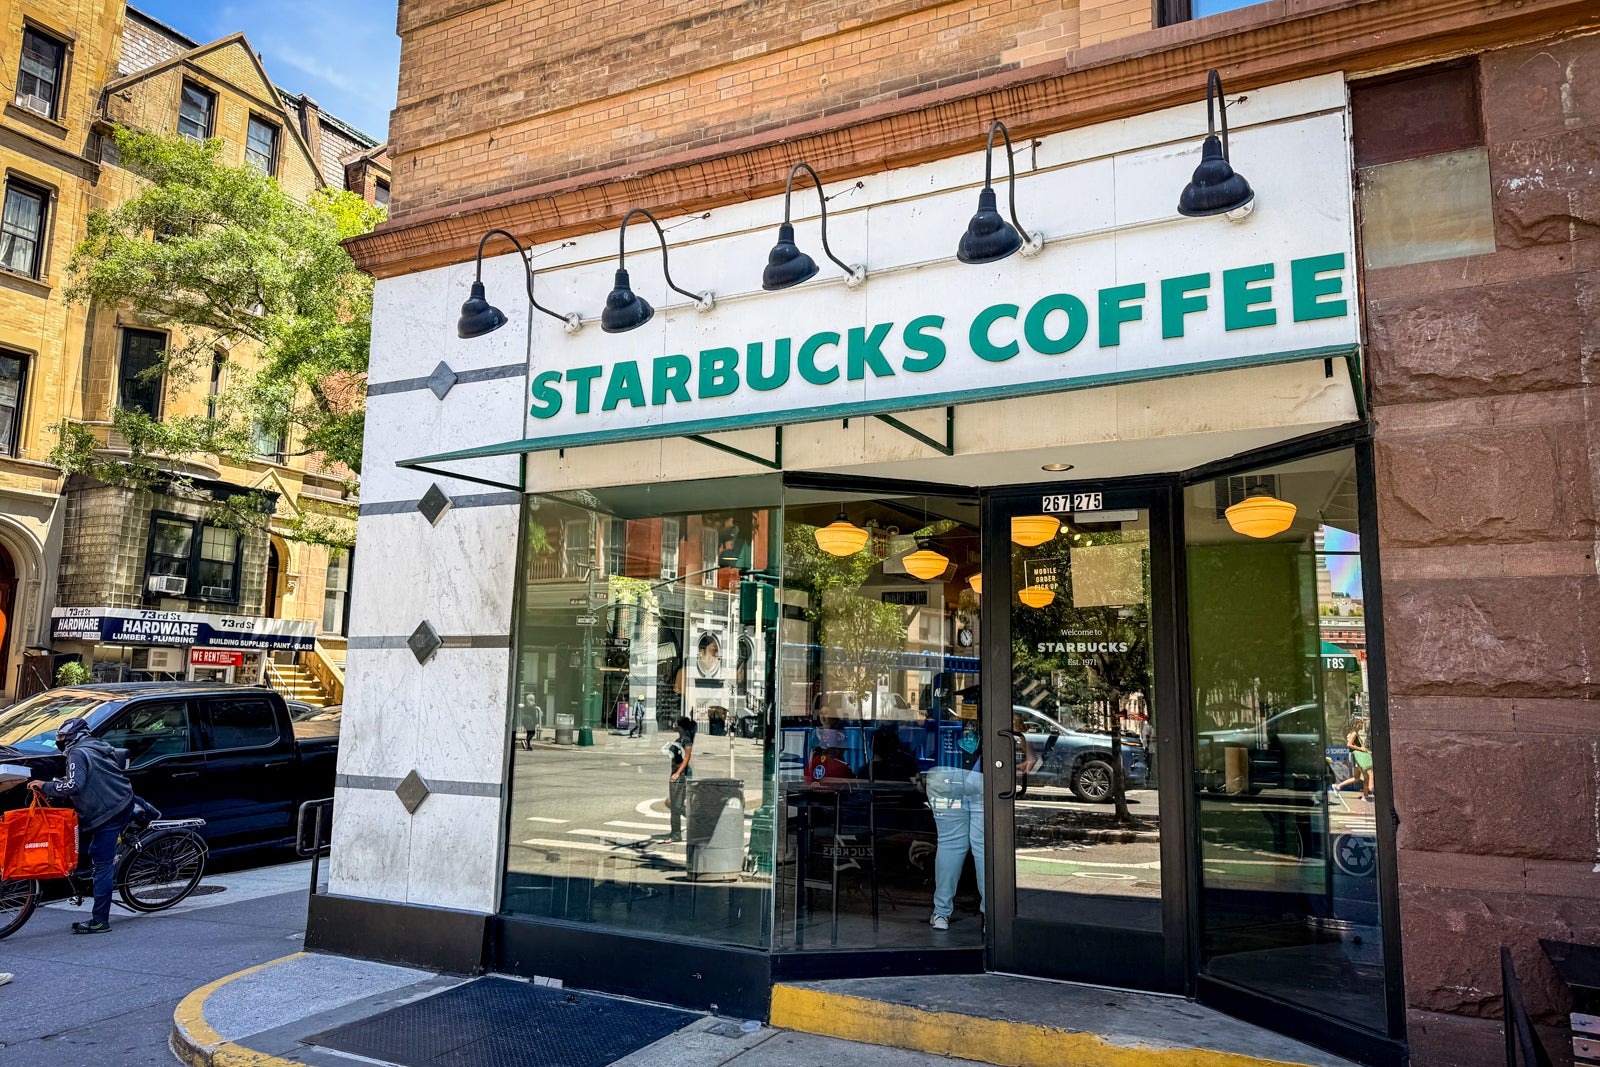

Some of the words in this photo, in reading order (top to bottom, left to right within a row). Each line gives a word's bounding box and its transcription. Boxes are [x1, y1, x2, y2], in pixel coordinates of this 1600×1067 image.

[530, 315, 946, 419] STARBUCKS
[969, 253, 1347, 362] COFFEE
[1033, 567, 1057, 575] MOBILE
[1035, 575, 1056, 583] ORDER
[69, 608, 84, 616] 73rd
[84, 608, 91, 616] St
[139, 610, 168, 620] 73rd
[170, 612, 181, 620] St
[58, 618, 99, 631] HARDWARE
[122, 619, 199, 636] HARDWARE
[221, 619, 245, 629] 73rd
[246, 621, 255, 630] St
[1061, 628, 1093, 636] Welcome
[112, 632, 146, 641] LUMBER
[152, 634, 195, 644] PLUMBING
[209, 637, 239, 646] BUILDING
[240, 640, 269, 648] SUPPLIES
[1037, 642, 1128, 653] STARBUCKS
[192, 650, 203, 661] WE
[203, 651, 220, 662] RENT
[1067, 658, 1080, 666] Est.
[1082, 658, 1097, 666] 1971
